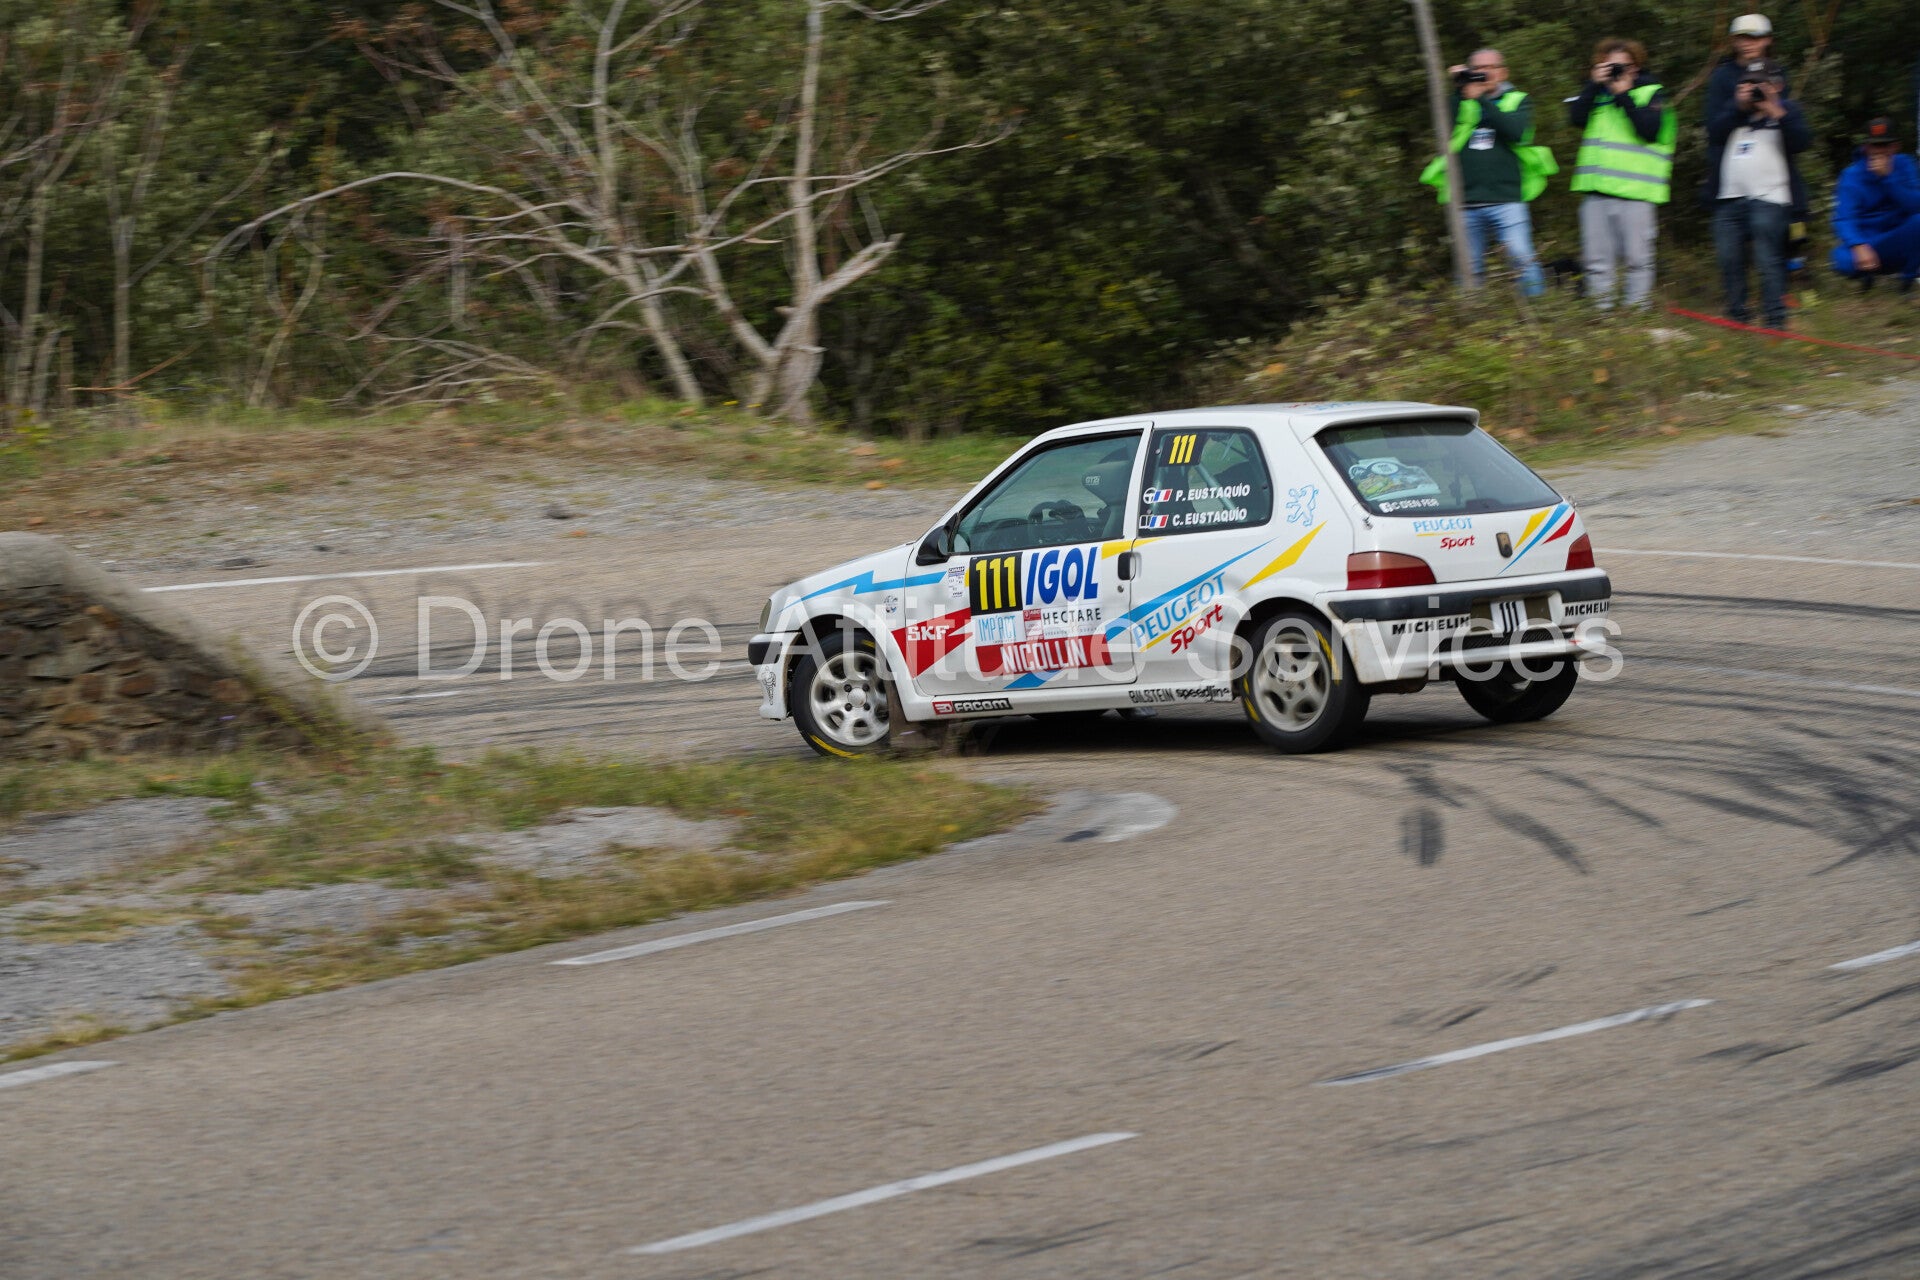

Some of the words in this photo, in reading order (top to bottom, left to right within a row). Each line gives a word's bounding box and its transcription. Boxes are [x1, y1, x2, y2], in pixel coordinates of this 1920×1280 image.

[1169, 434, 1197, 464] 111
[1412, 517, 1472, 532] PEUGEOT
[1440, 535, 1475, 549] Sport
[975, 556, 1017, 611] 111
[1026, 546, 1099, 606] IGOL
[1042, 608, 1102, 625] HECTARE
[1131, 571, 1226, 648] PEUGEOT
[1499, 601, 1522, 632] 111
[907, 624, 950, 642] SKF
[1171, 604, 1224, 654] Sport
[1392, 616, 1471, 635] MICHELIN
[1000, 638, 1088, 674] NICOLLIN
[954, 699, 1010, 712] FACOM
[1128, 688, 1176, 703] BILSTEIN
[1176, 685, 1230, 703] speedline
